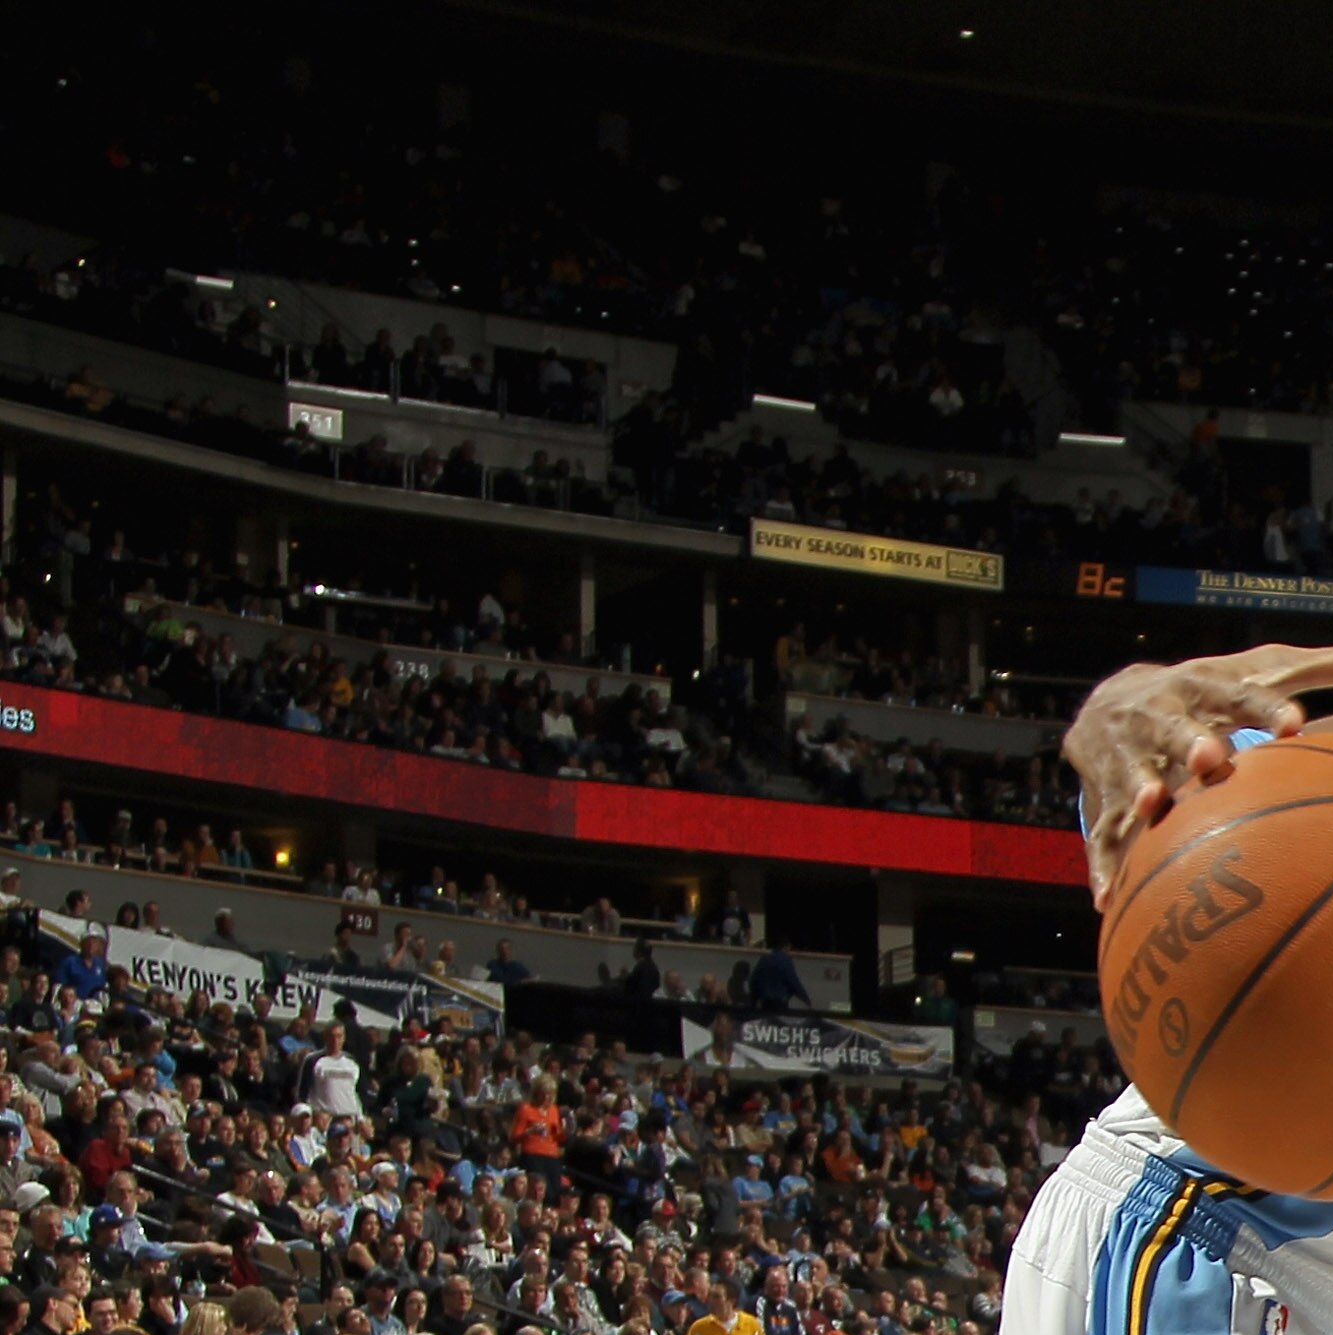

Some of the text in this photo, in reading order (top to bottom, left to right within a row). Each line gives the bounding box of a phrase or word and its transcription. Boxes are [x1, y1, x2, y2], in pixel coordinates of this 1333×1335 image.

[755, 530, 801, 550] EVERY
[807, 537, 865, 560] SEASON
[869, 546, 922, 568] STARTS
[925, 555, 942, 570] AT
[1233, 571, 1297, 592] DENVER
[131, 956, 237, 1001] KENYON'S
[742, 1022, 821, 1046] SWISH'S
